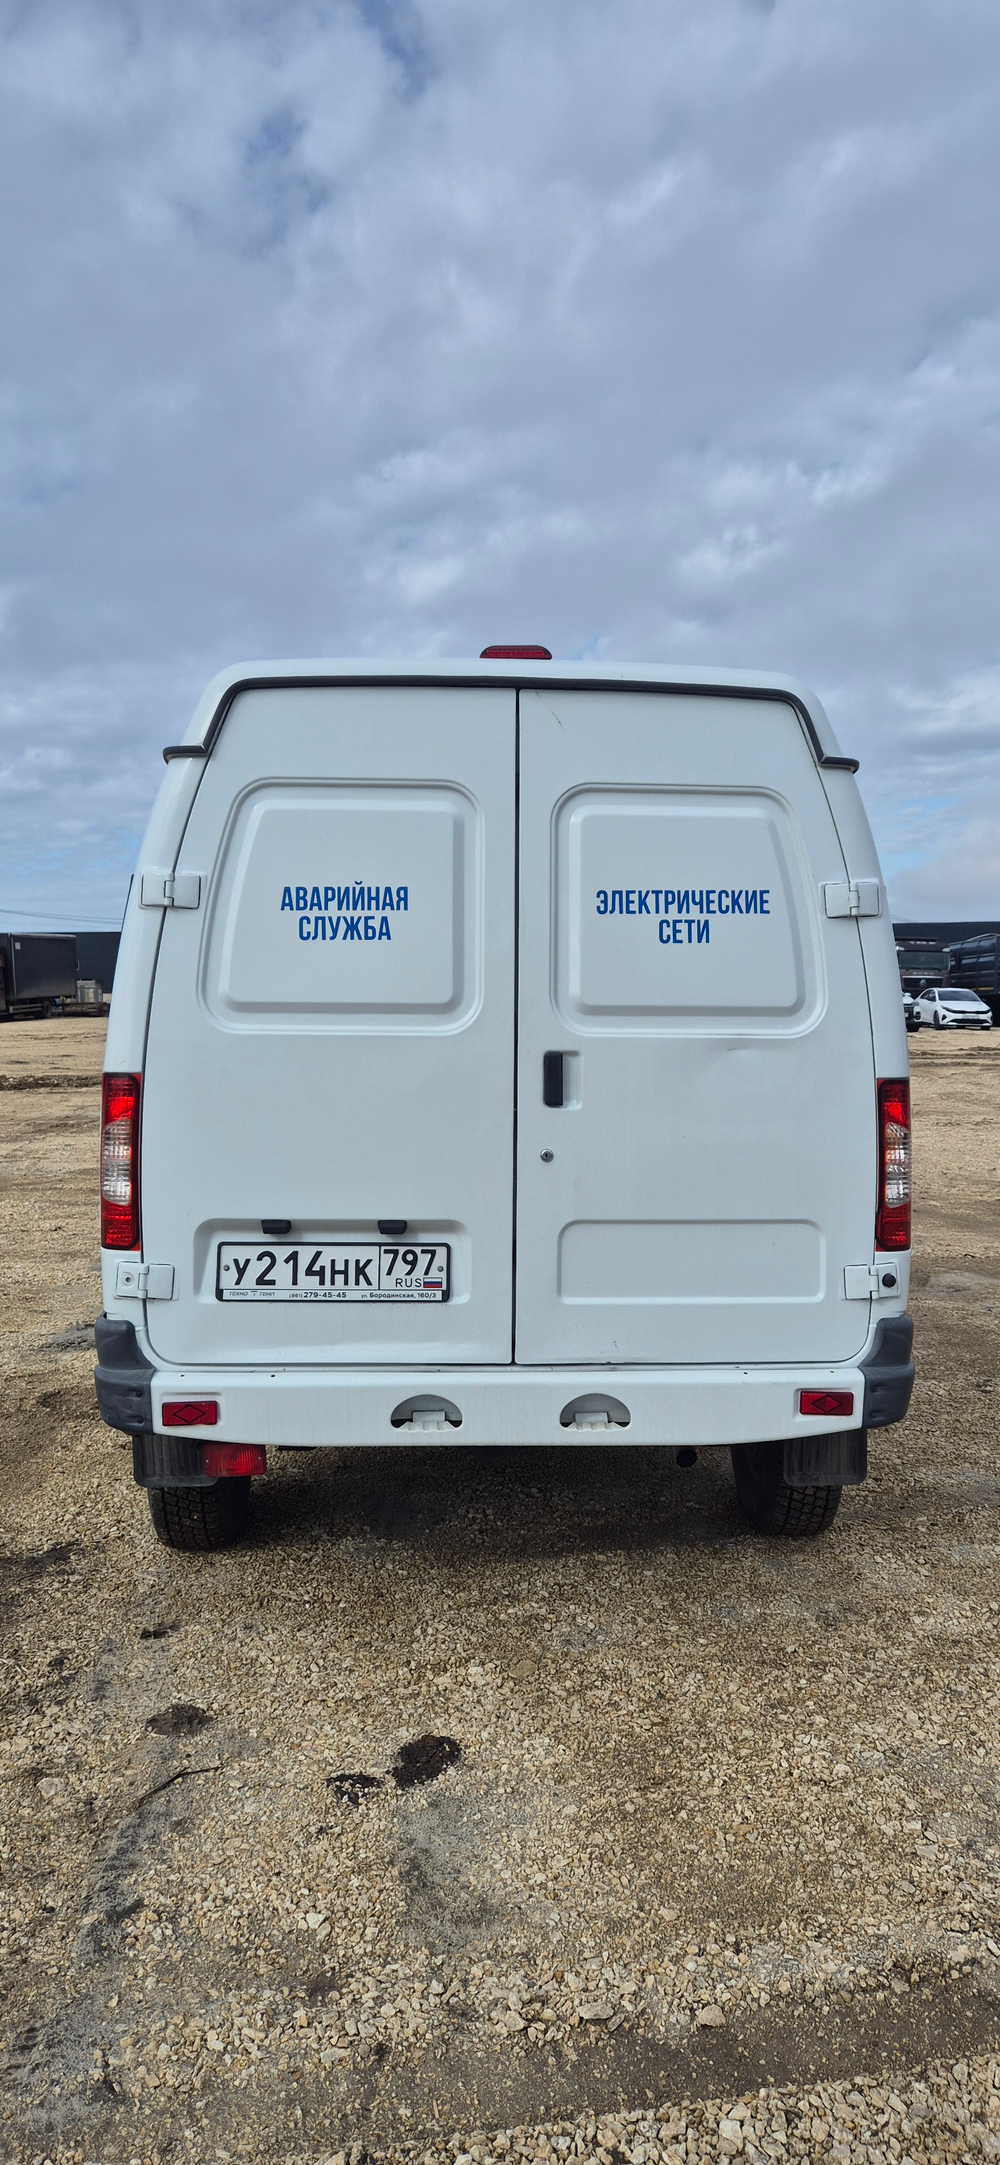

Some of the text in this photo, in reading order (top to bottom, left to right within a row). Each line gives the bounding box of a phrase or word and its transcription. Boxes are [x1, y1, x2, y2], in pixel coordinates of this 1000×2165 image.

[280, 880, 409, 911] АВАРИЙНАЯ
[596, 889, 771, 914] ЭЛЕКТРИЧЕСКИЕ
[298, 915, 392, 941] СЛУЖБА
[658, 919, 710, 944] СЕТИ
[383, 1249, 437, 1276] 797
[395, 1277, 422, 1288] RUS
